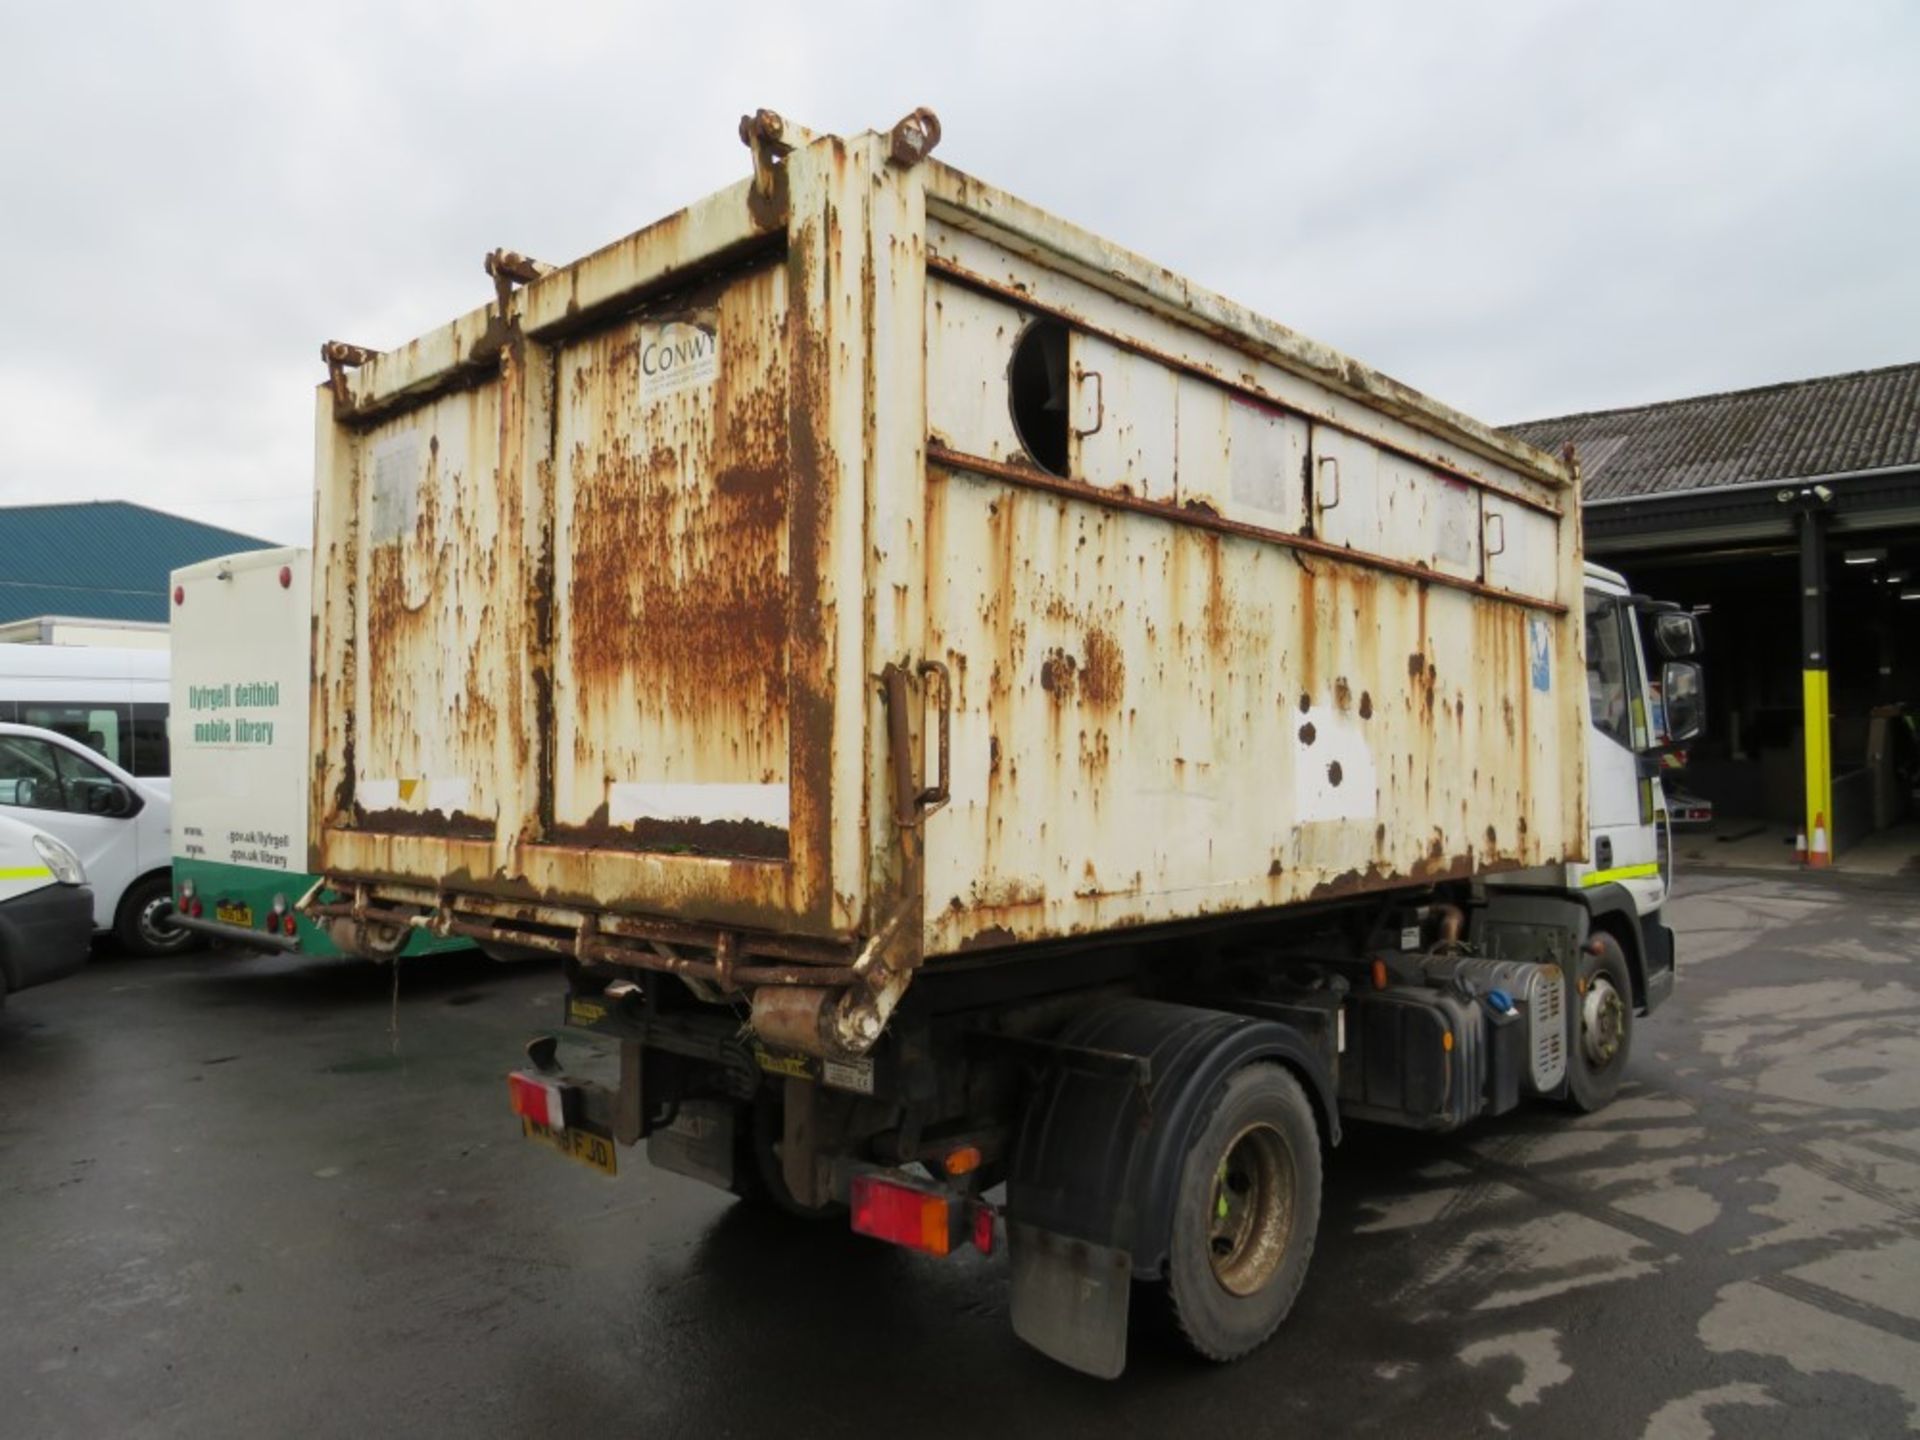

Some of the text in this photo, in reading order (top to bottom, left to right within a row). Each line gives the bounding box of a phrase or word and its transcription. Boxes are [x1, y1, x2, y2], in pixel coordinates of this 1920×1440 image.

[190, 681, 279, 710] llyfrgell deithiol
[195, 718, 273, 745] mobile library
